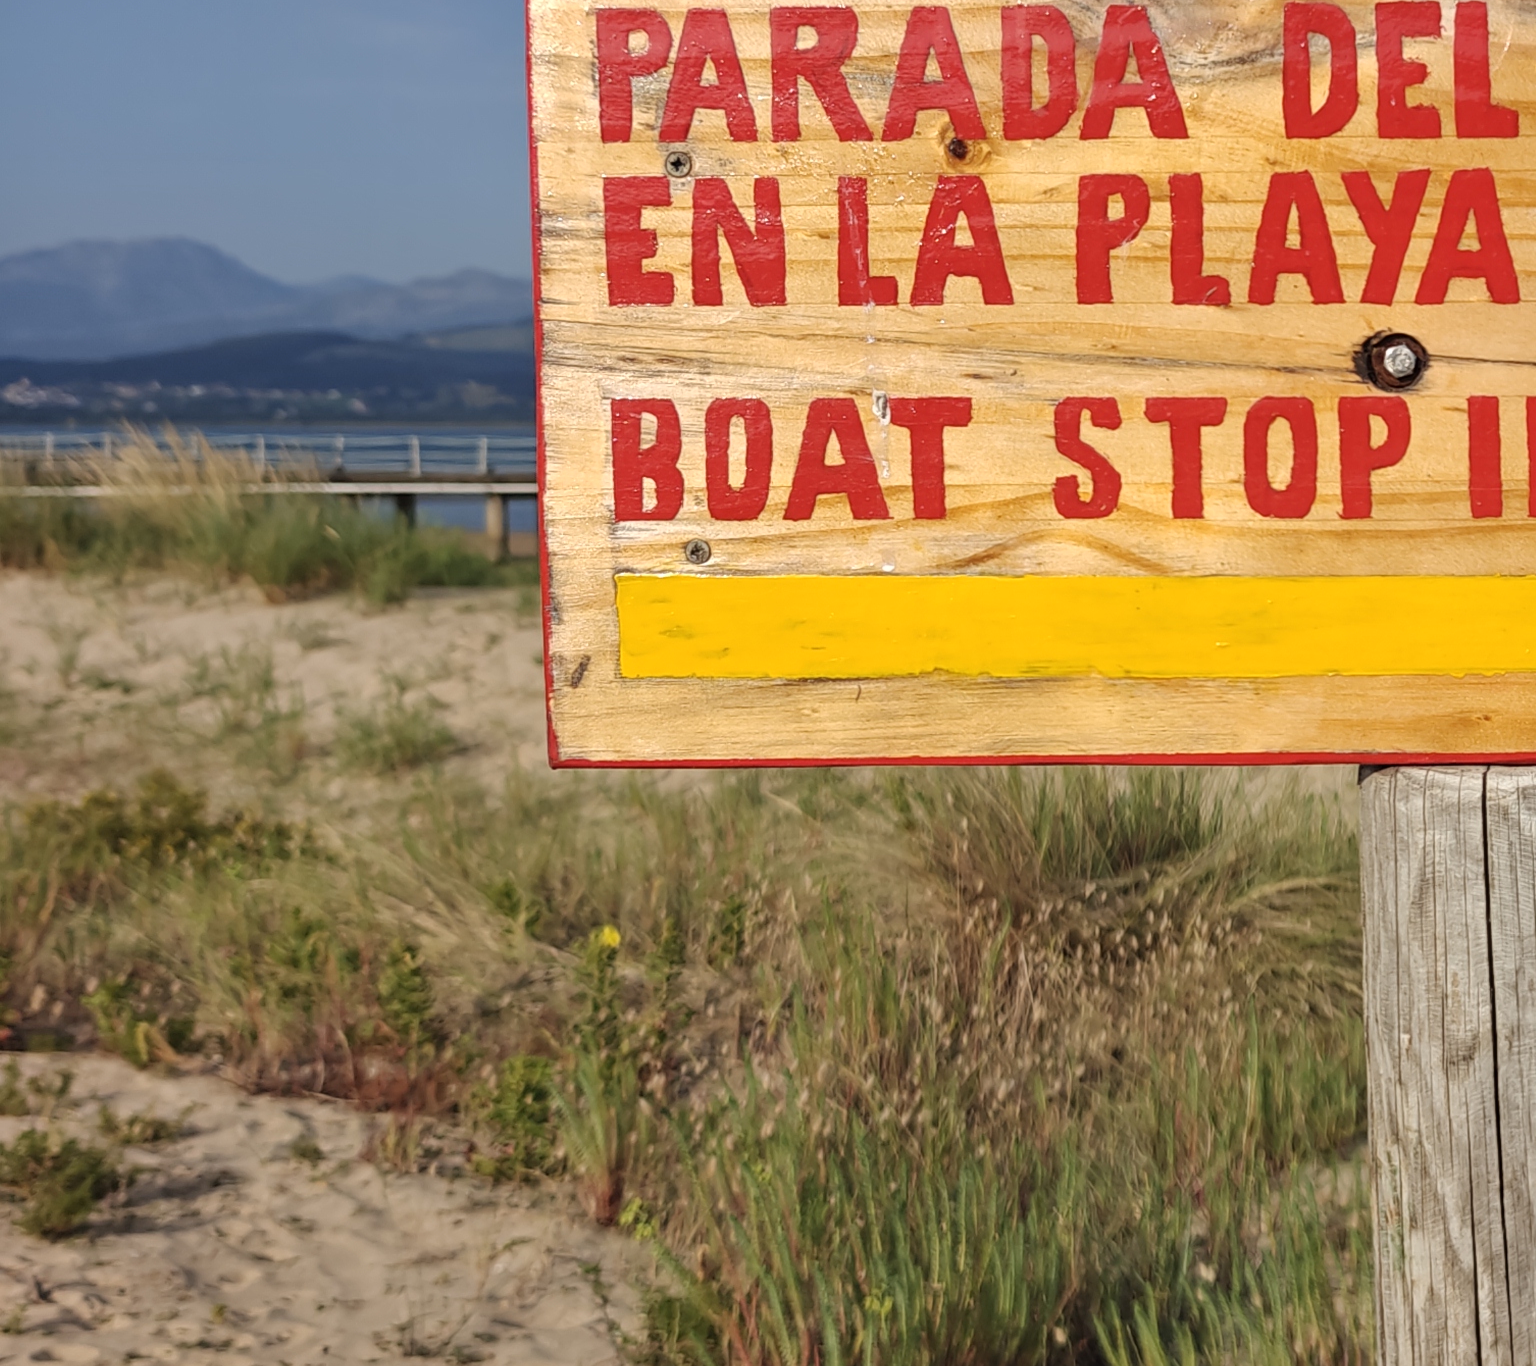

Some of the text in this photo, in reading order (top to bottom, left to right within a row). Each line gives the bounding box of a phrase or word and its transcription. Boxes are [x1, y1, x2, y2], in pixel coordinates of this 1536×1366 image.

[595, 5, 1188, 143] PARADA
[1283, 1, 1519, 139] DEL
[602, 168, 1521, 307] EN LA PLAYA
[611, 397, 973, 522] BOAT
[1053, 397, 1412, 520] STOP
